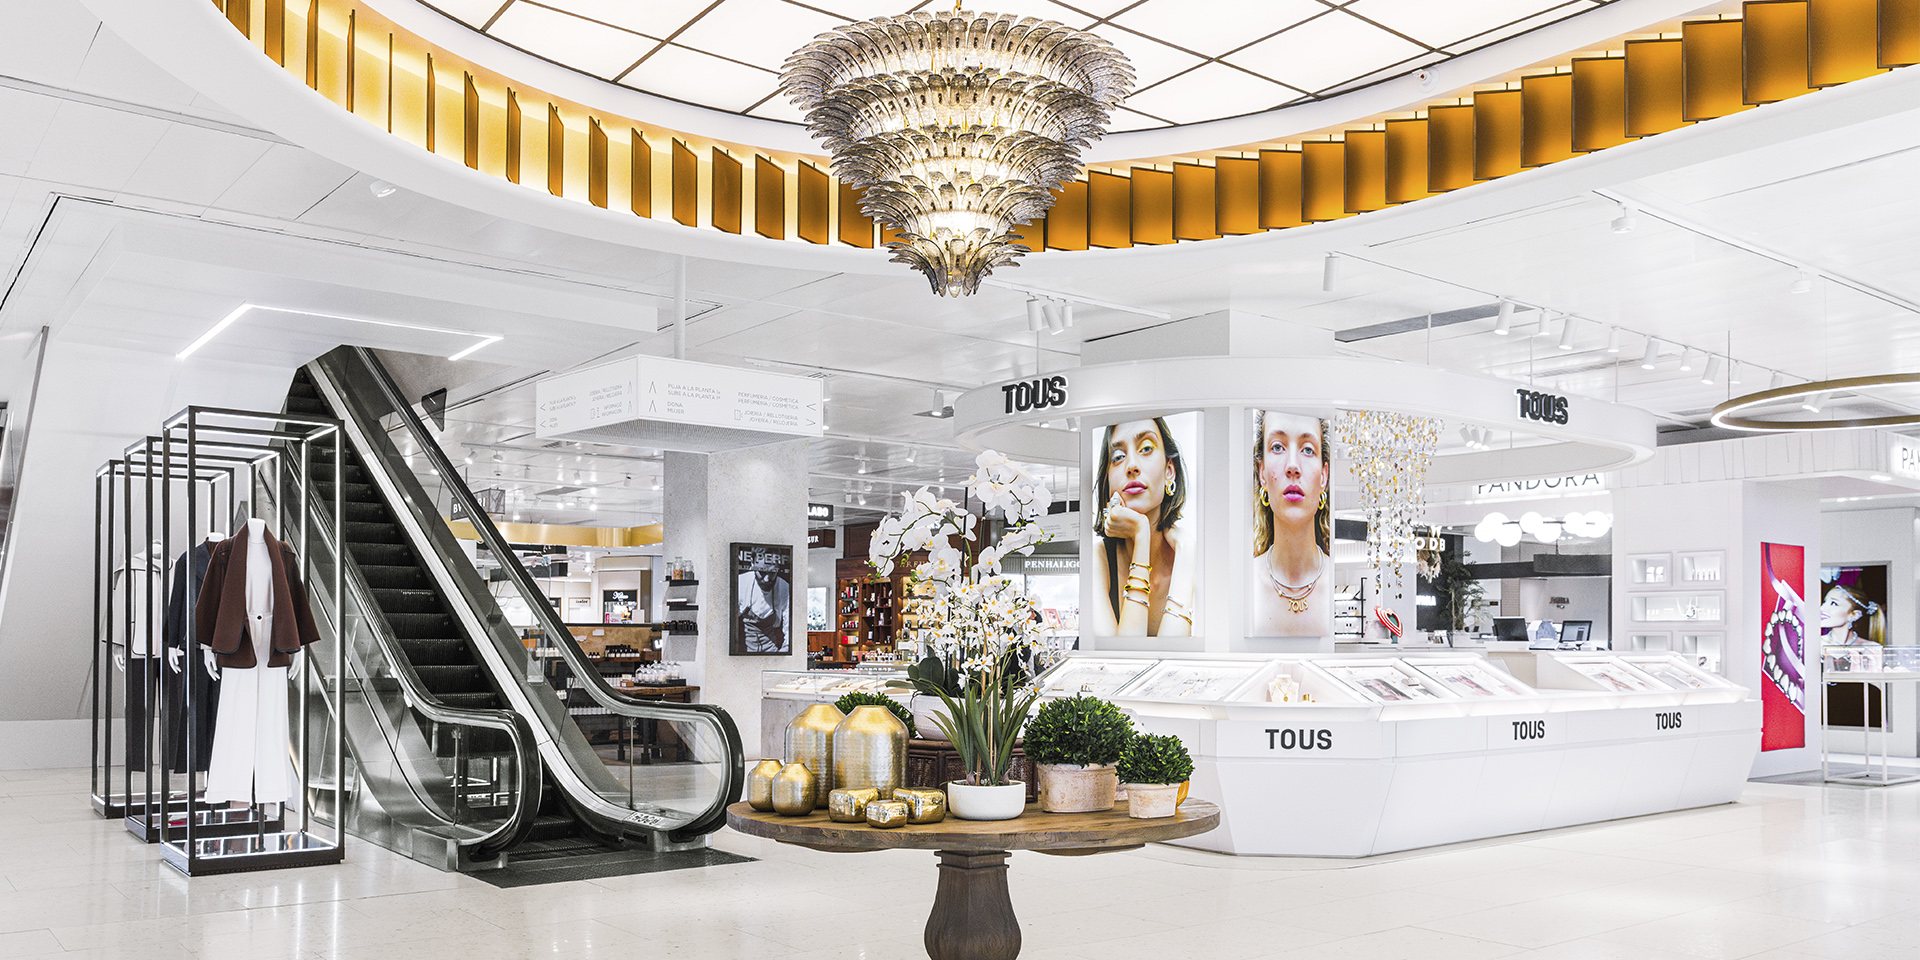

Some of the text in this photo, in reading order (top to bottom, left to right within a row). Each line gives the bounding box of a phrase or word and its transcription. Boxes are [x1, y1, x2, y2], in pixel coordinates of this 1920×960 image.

[1002, 376, 1067, 414] TOUS
[1516, 388, 1569, 425] TOUS
[1512, 720, 1545, 740] TOUS
[1655, 711, 1682, 730] TOUS
[1265, 728, 1333, 750] TOUS
